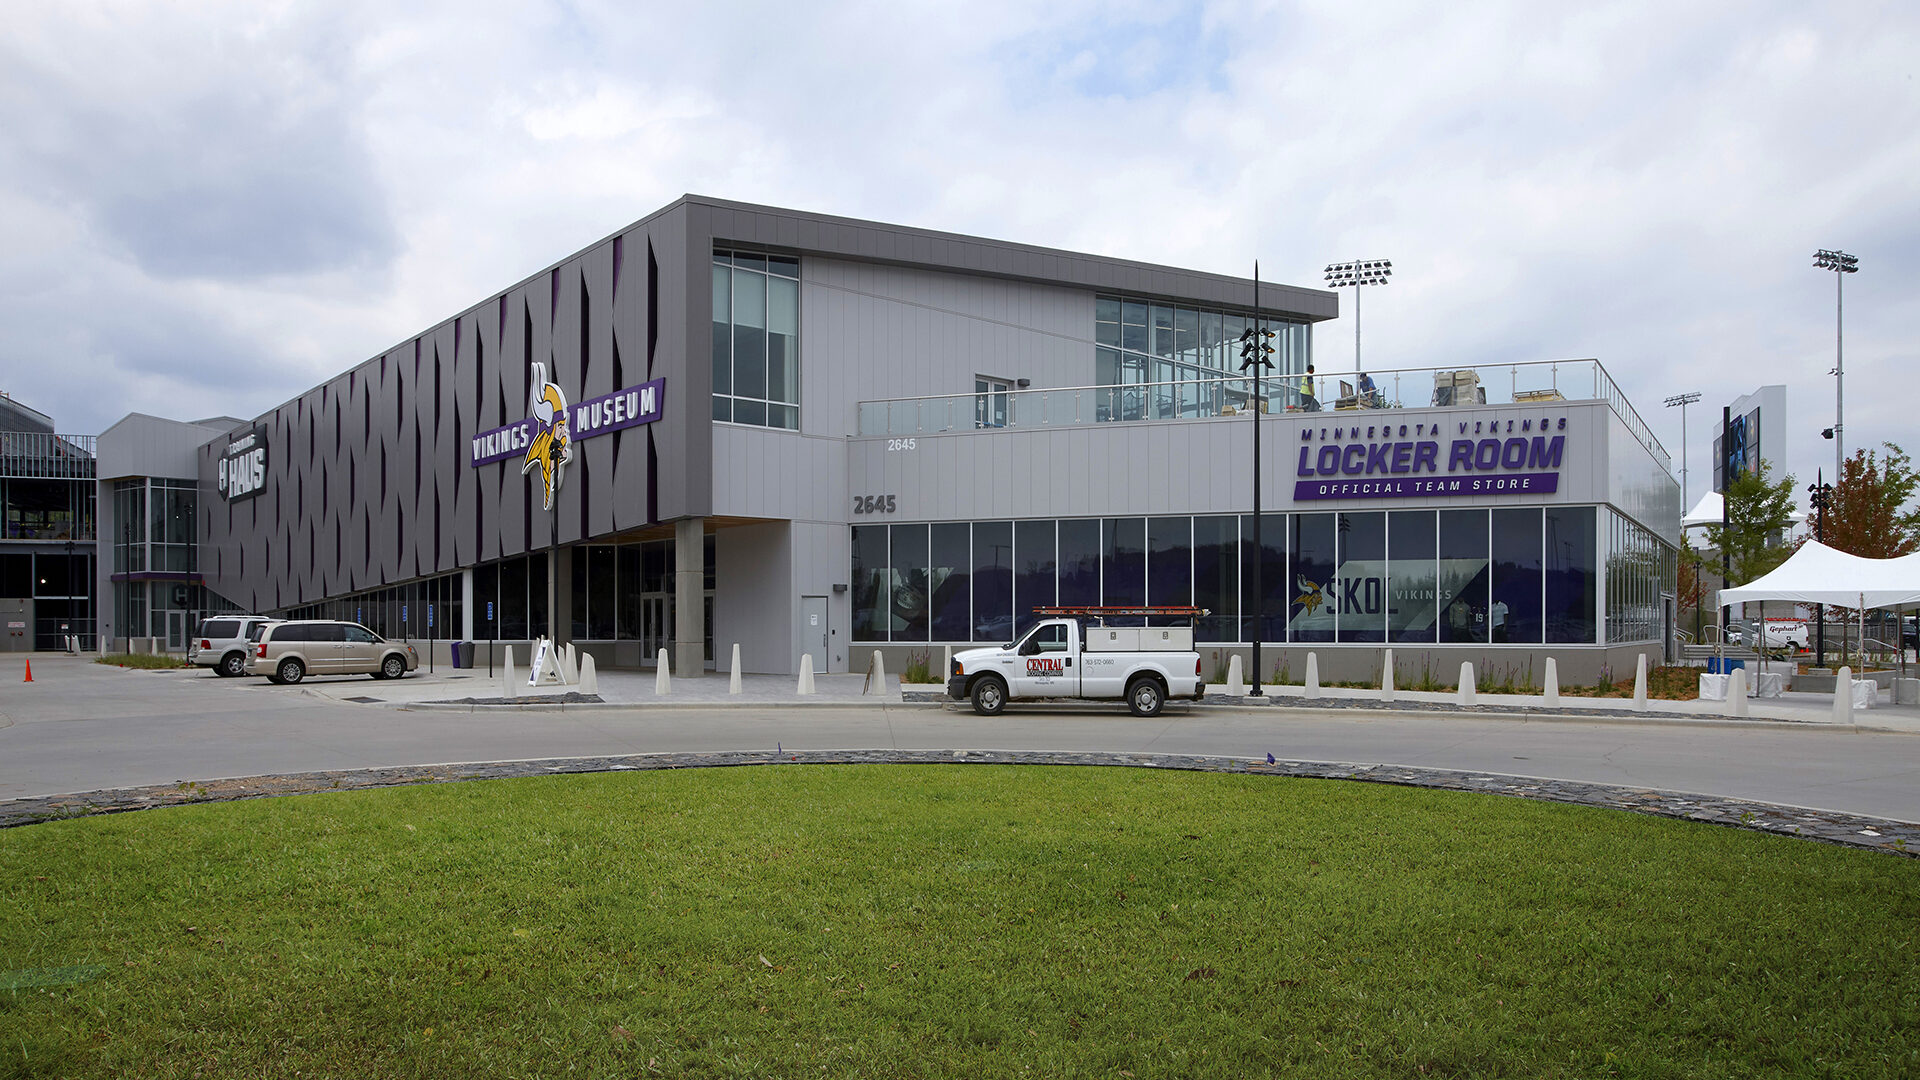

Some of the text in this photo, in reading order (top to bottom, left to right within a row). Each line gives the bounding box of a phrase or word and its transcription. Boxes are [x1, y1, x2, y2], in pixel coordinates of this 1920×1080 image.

[473, 387, 656, 460] VIKINGS MUSEUM
[1301, 417, 1567, 441] MINNESOTA VIKINGS
[888, 439, 916, 451] 2645
[1297, 435, 1566, 477] LOCKER ROOM
[219, 447, 264, 498] H HAUS
[1319, 478, 1530, 495] OFFICIAL TEAM STORE
[854, 495, 896, 514] 2645
[1326, 577, 1452, 615] SKOL VIKINGS
[1475, 613, 1484, 622] 19
[1770, 624, 1797, 633] Gephart
[1026, 658, 1063, 671] CENTRAL
